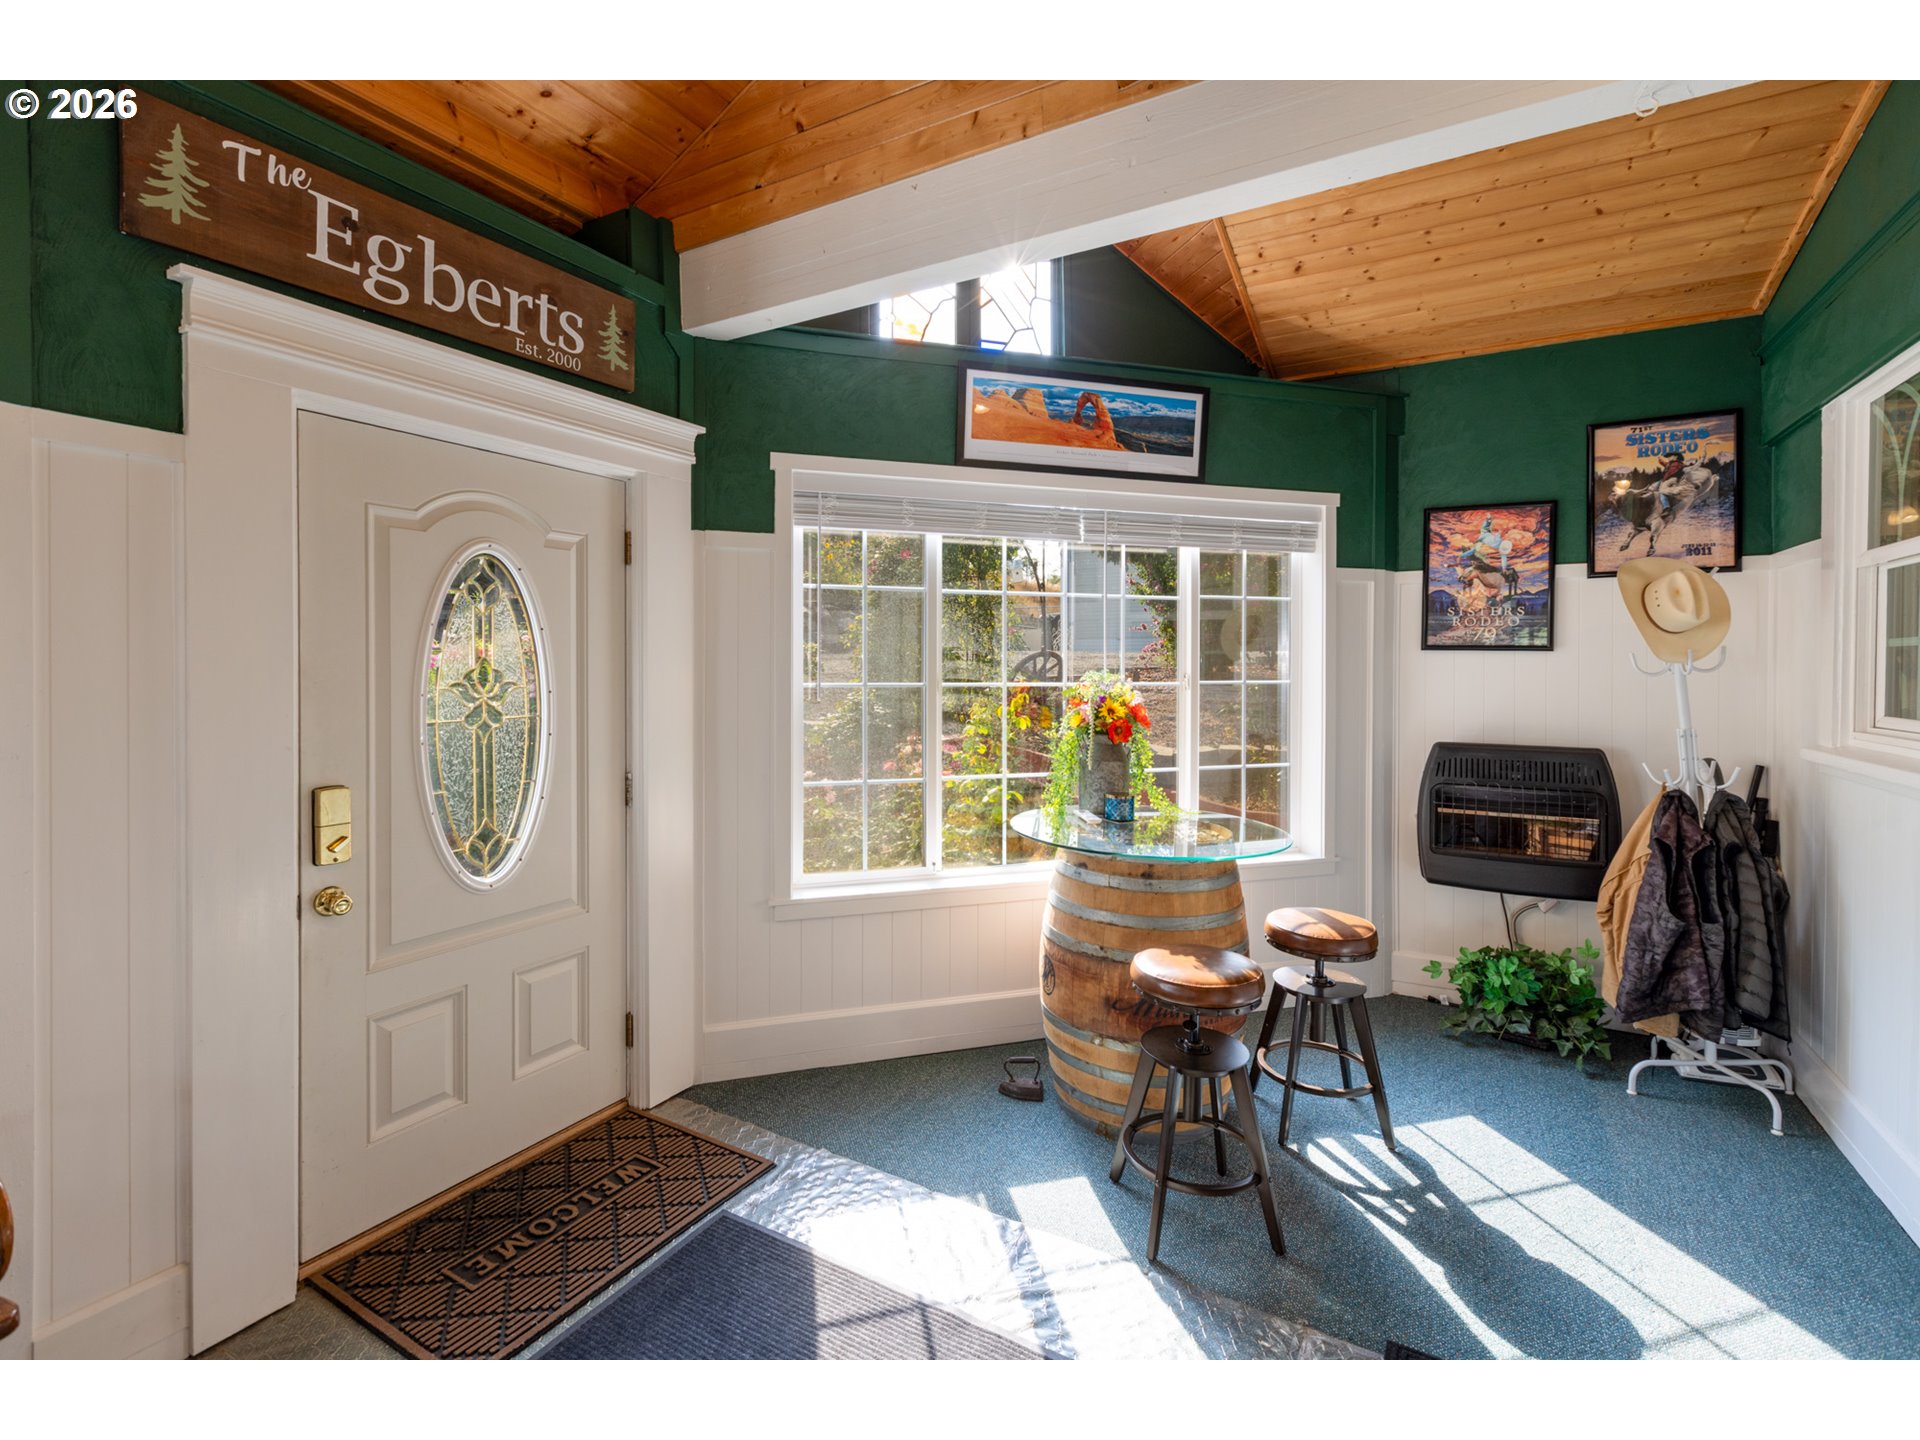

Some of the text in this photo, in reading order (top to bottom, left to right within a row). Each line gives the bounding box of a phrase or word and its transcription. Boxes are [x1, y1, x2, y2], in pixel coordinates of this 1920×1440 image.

[222, 140, 312, 189] The
[306, 189, 584, 354] Egberts
[515, 337, 581, 372] Est. 2000
[1625, 426, 1710, 447] SISTERS
[1636, 441, 1698, 458] RODEO
[1685, 546, 1712, 557] 2011
[1447, 606, 1525, 617] SISTERS
[1452, 617, 1520, 627] RODEO
[464, 1164, 651, 1276] WELCOME
